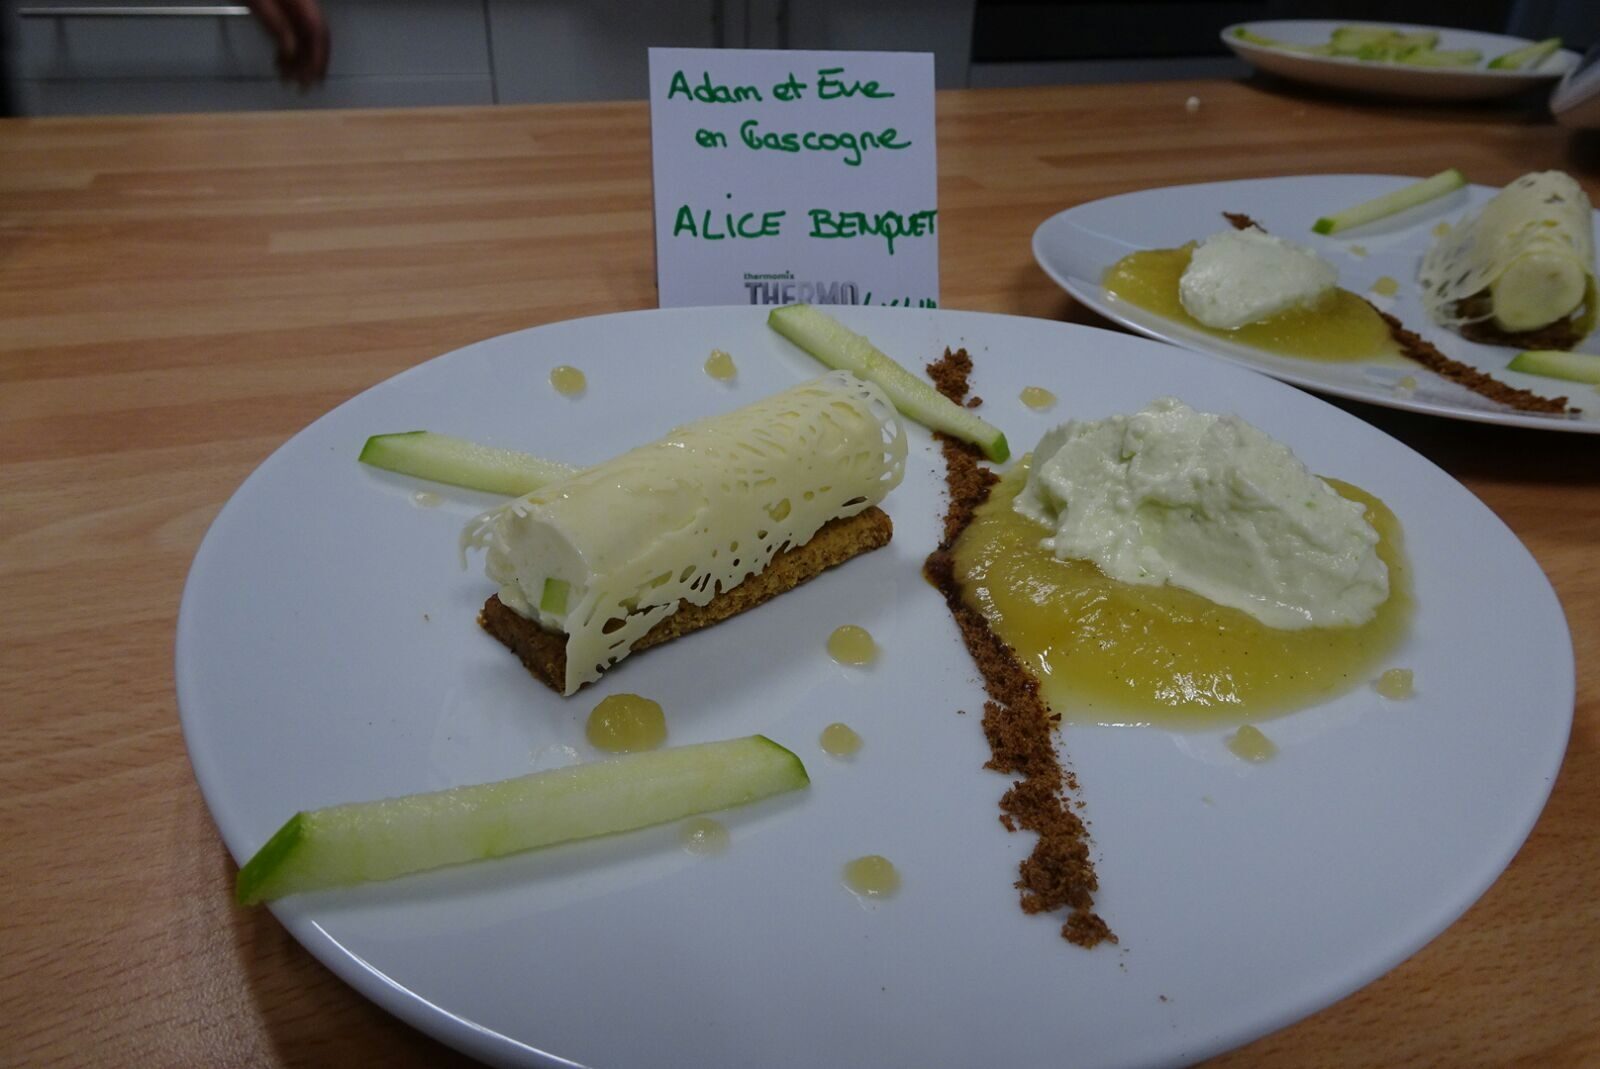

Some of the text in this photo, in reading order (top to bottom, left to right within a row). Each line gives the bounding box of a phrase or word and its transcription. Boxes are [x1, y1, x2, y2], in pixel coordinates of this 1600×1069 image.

[668, 68, 895, 103] Adam et Eve
[695, 120, 912, 167] en Gascogne
[808, 208, 938, 256] BENQUET
